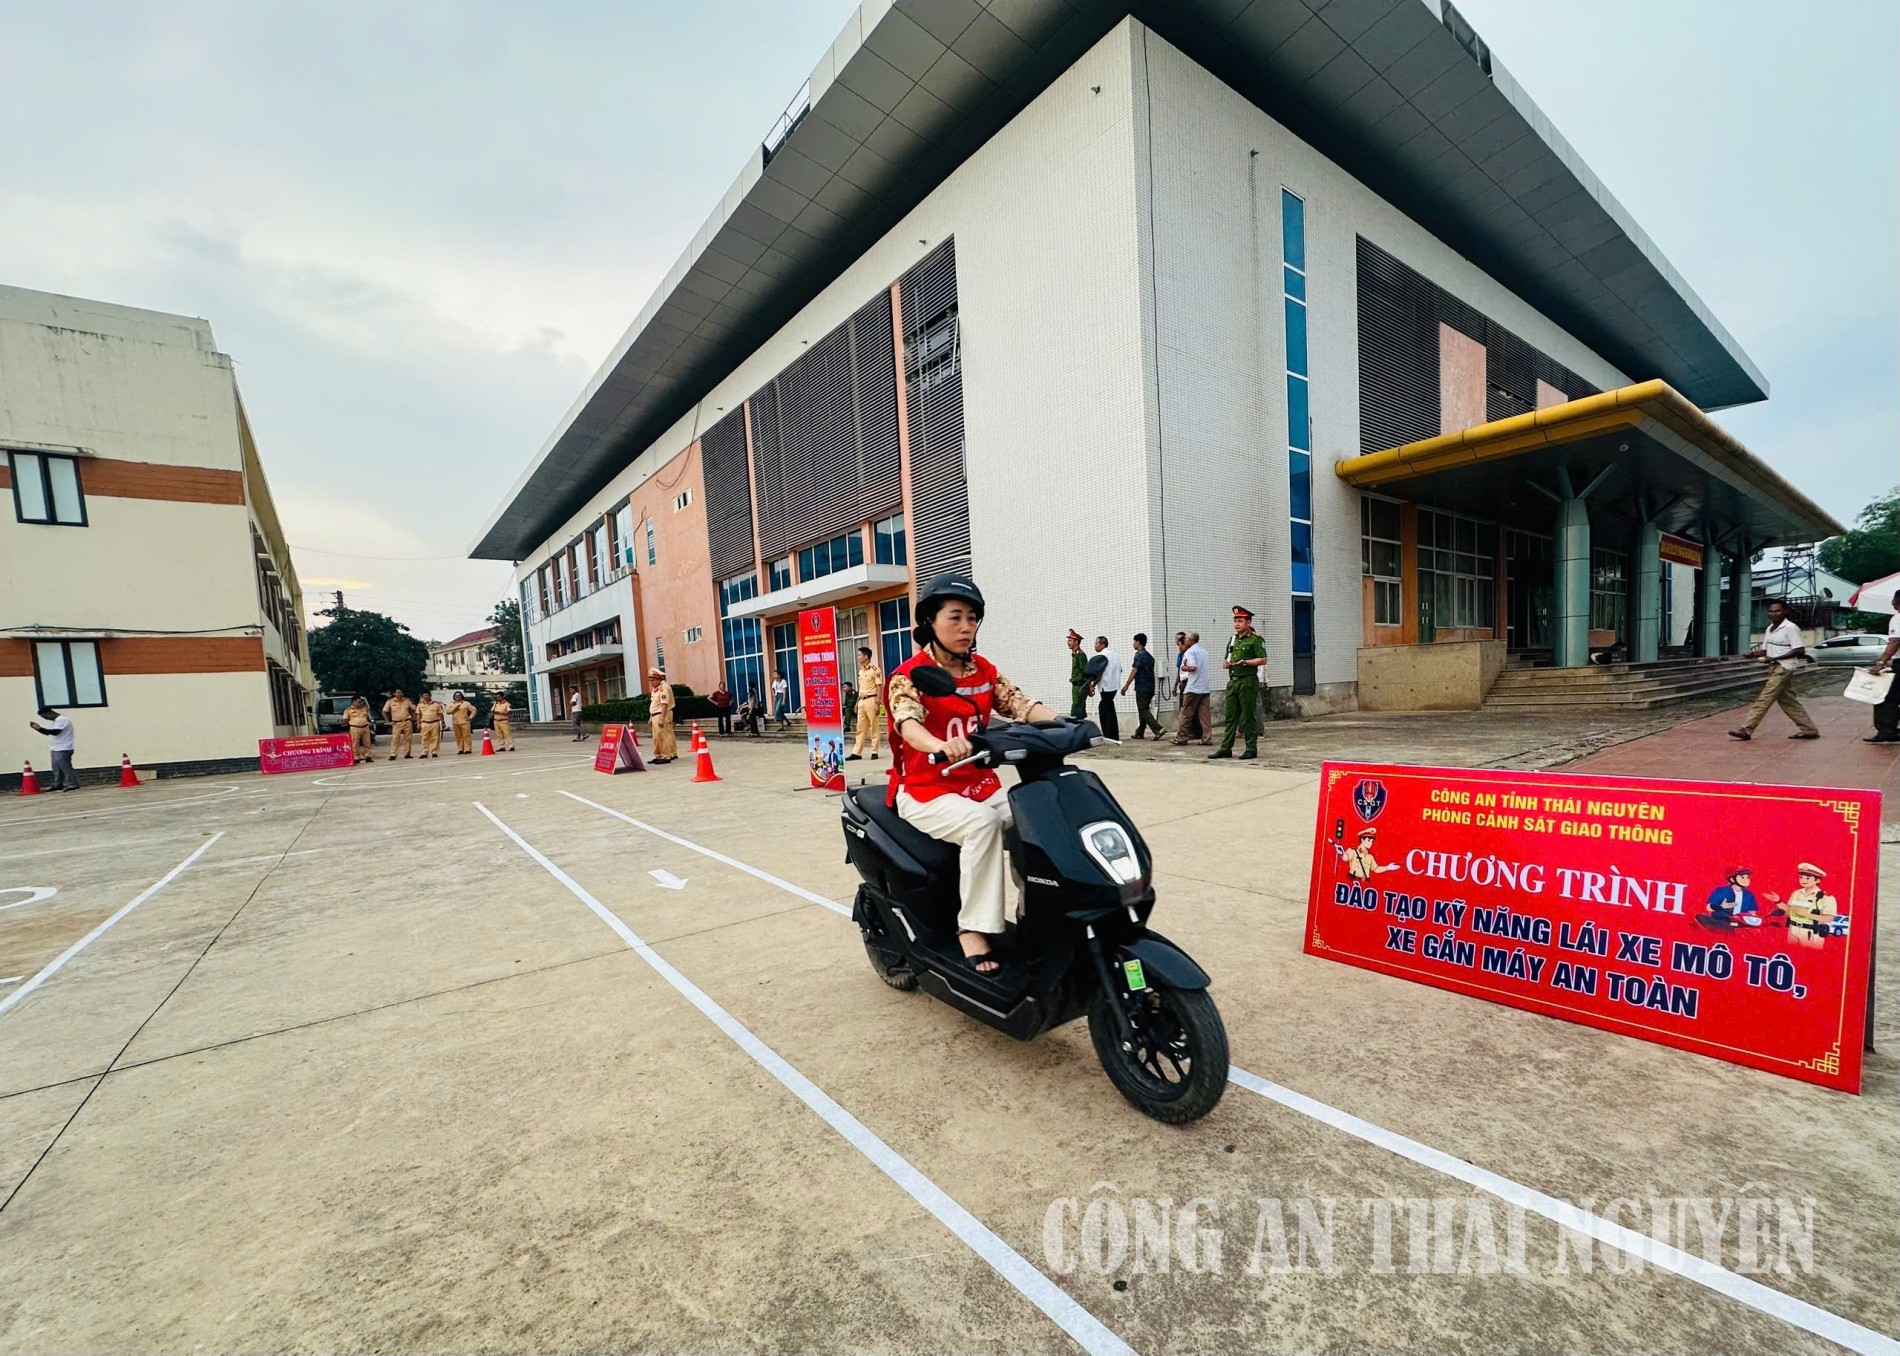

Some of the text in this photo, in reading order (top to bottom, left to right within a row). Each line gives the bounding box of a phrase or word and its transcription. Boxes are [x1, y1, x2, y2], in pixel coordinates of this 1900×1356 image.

[283, 746, 332, 756] CHƯƠNG TRÌNH
[1357, 798, 1382, 807] CSGT
[1431, 787, 1666, 821] CÔNG AN TỈNH THÁI NGUYÊN
[1422, 808, 1674, 846] PHÒNG CẢNH SÁT GIAO THÔNG
[1406, 849, 1689, 915] CHƯƠNG TRÌNH
[1334, 881, 1807, 999] ĐÀO TẠO KỸ NĂNG LÁI XE MÔ TÔ,
[1386, 926, 1699, 1019] XE GẮN MÁY AN TOÀN
